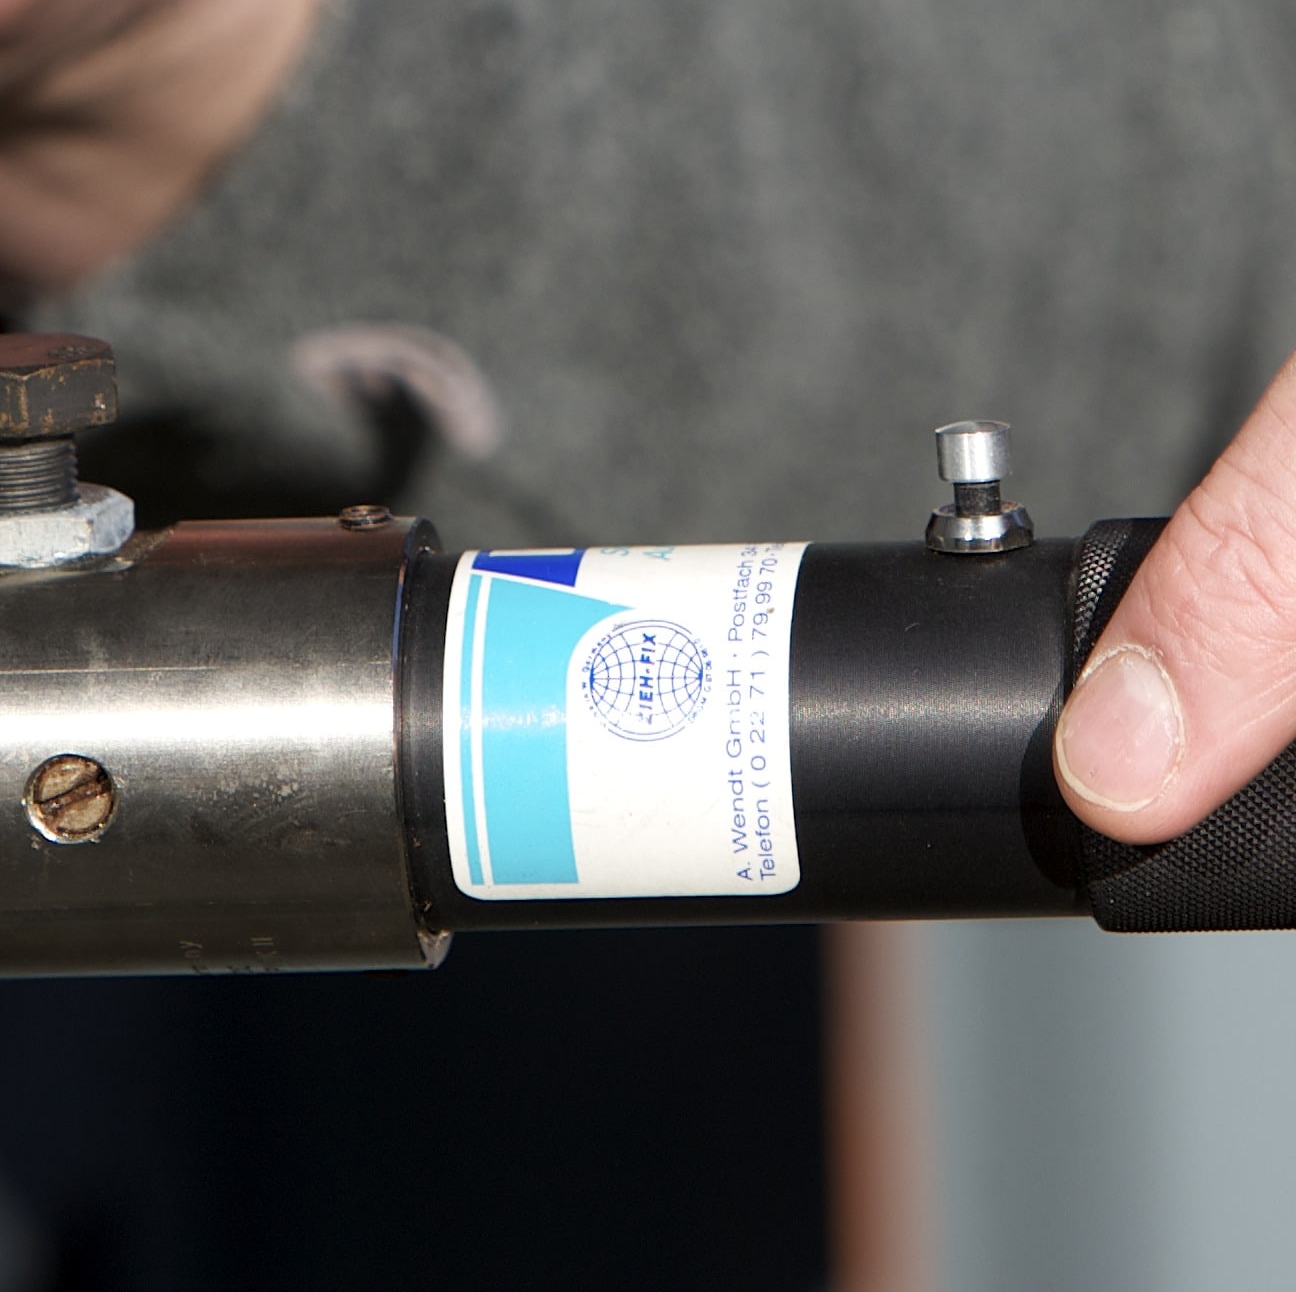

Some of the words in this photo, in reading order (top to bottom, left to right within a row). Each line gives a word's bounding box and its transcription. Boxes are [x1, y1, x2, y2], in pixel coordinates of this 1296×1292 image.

[727, 560, 753, 642] Postfach
[755, 581, 773, 605] 99
[725, 668, 744, 758] GmbH
[749, 712, 767, 744] 22
[727, 769, 748, 854] Wendt
[754, 799, 777, 882] Telefon
[735, 860, 753, 882] A.
